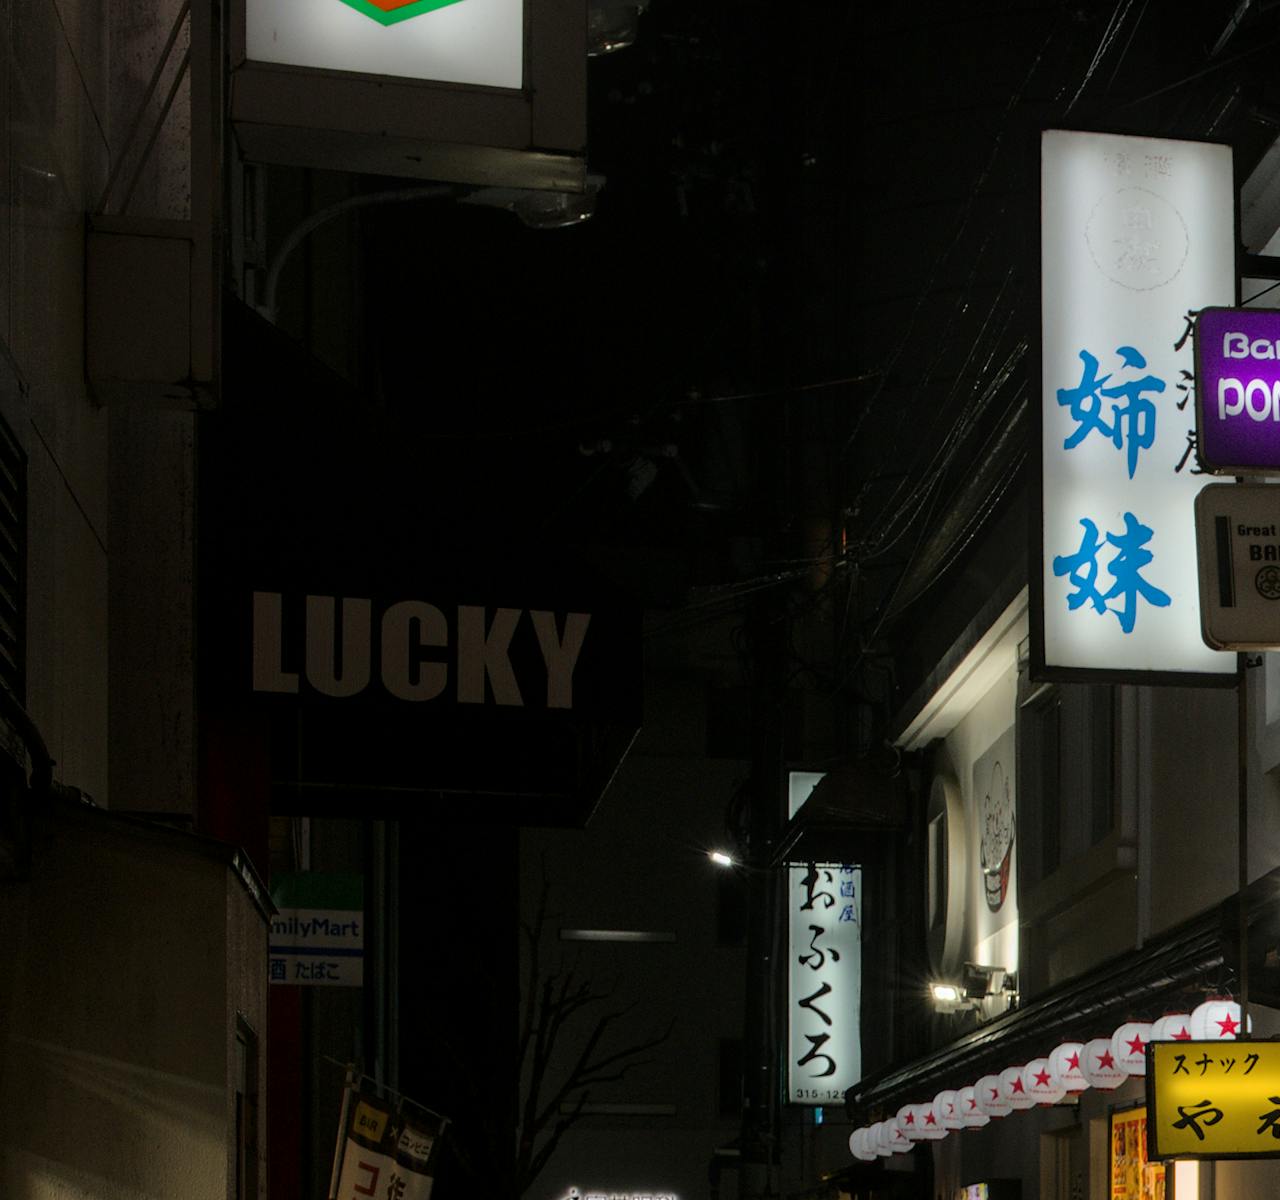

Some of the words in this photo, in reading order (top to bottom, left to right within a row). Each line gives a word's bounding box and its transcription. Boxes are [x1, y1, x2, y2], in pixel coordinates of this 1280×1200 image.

[1053, 345, 1172, 635] 姉妹
[1237, 524, 1276, 538] Great
[252, 590, 592, 710] LUCKY
[296, 960, 340, 980] たばこ
[797, 867, 841, 1079] おふくろ
[1172, 1052, 1260, 1077] スナック
